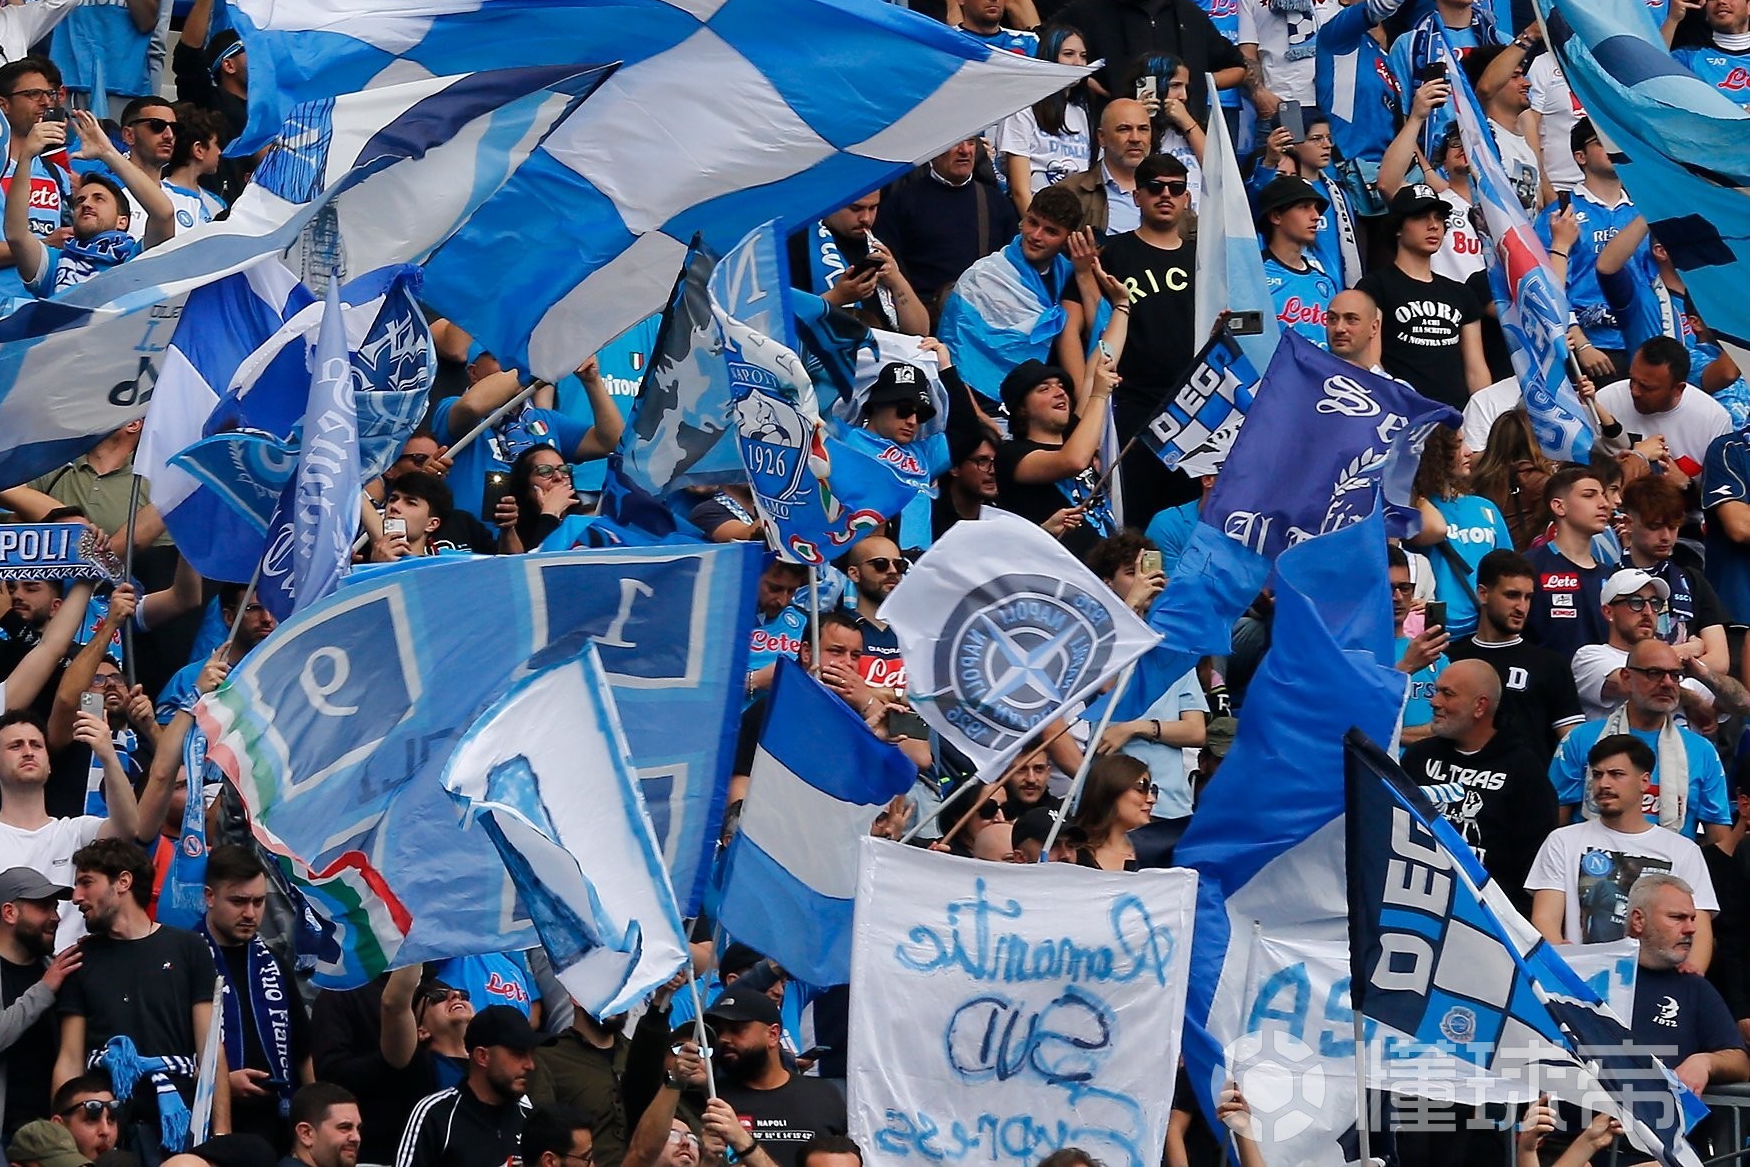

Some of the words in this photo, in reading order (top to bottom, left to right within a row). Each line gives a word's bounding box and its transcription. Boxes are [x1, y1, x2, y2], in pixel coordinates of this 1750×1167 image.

[30, 187, 59, 208] ete
[1426, 326, 1451, 335] SCRITTO
[1408, 334, 1440, 346] NOSTRA
[746, 445, 787, 478] 1926
[1542, 575, 1578, 590] Lete
[750, 629, 802, 655] Lete
[1424, 756, 1508, 792] ULTRAS
[754, 1119, 784, 1128] NAPOLI
